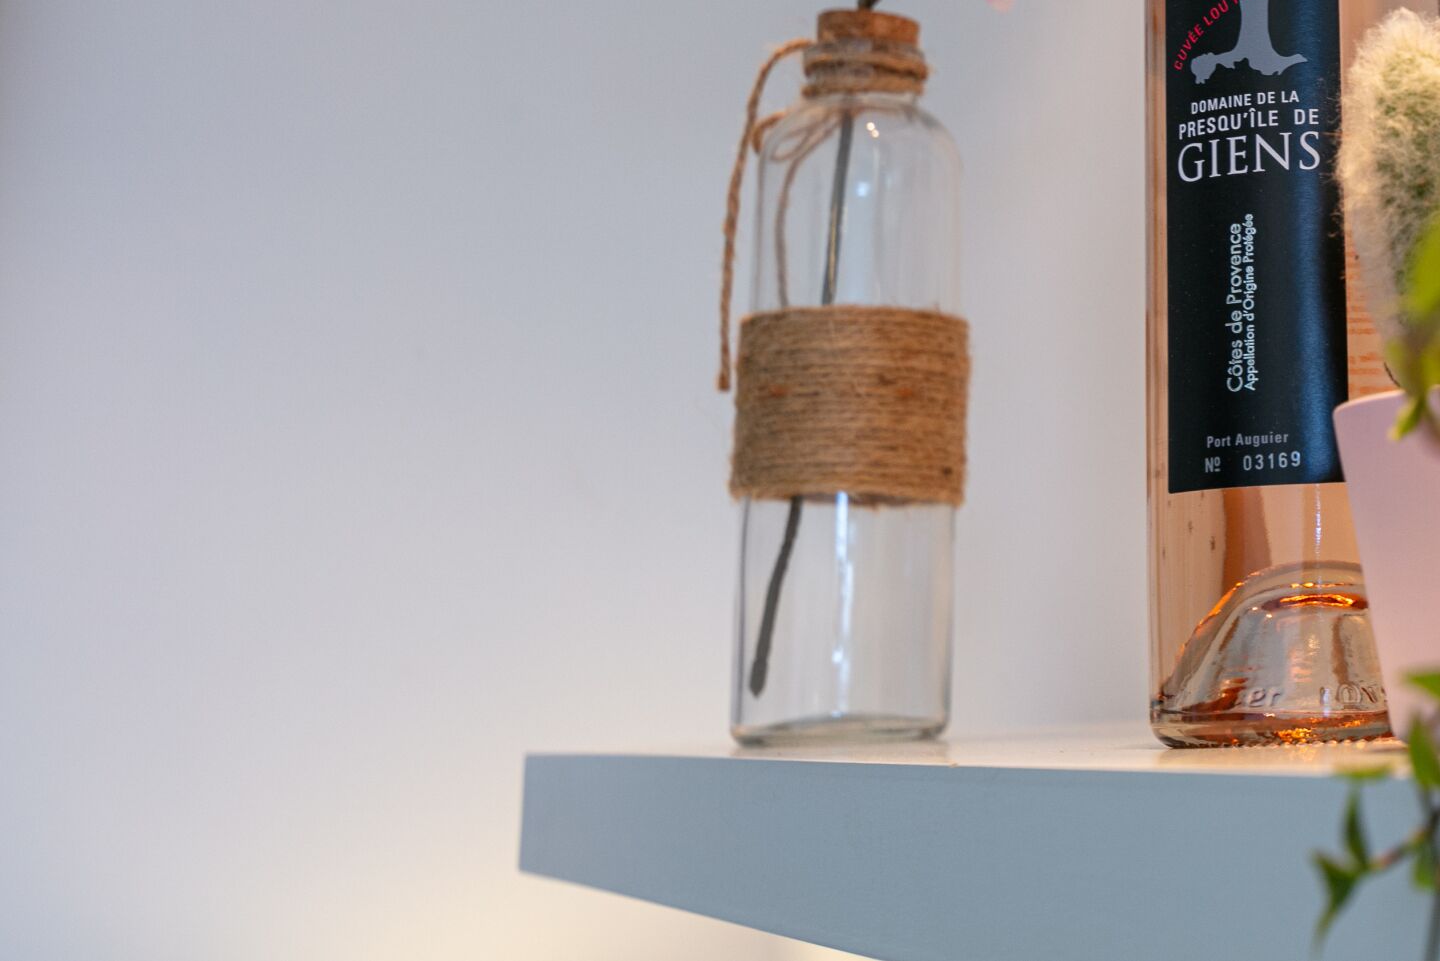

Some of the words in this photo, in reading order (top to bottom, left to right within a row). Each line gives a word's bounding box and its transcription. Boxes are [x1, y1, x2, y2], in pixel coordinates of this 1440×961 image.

[1174, 24, 1205, 71] CUVÉE
[1202, 0, 1229, 27] LOU
[1178, 107, 1279, 140] PRESQU'ÎLE
[1294, 108, 1320, 125] DE
[1190, 93, 1252, 115] DOMAINE
[1257, 91, 1276, 105] DE
[1281, 90, 1300, 103] LA
[1177, 130, 1321, 183] GIENS
[1226, 223, 1243, 305] Provence
[1242, 266, 1258, 321] d'Origine
[1224, 310, 1243, 334] de
[1226, 339, 1244, 392] Côtes
[1243, 324, 1259, 391] Appellation
[1206, 435, 1231, 449] Port
[1235, 431, 1289, 448] Auguier
[1243, 450, 1301, 471] 03169
